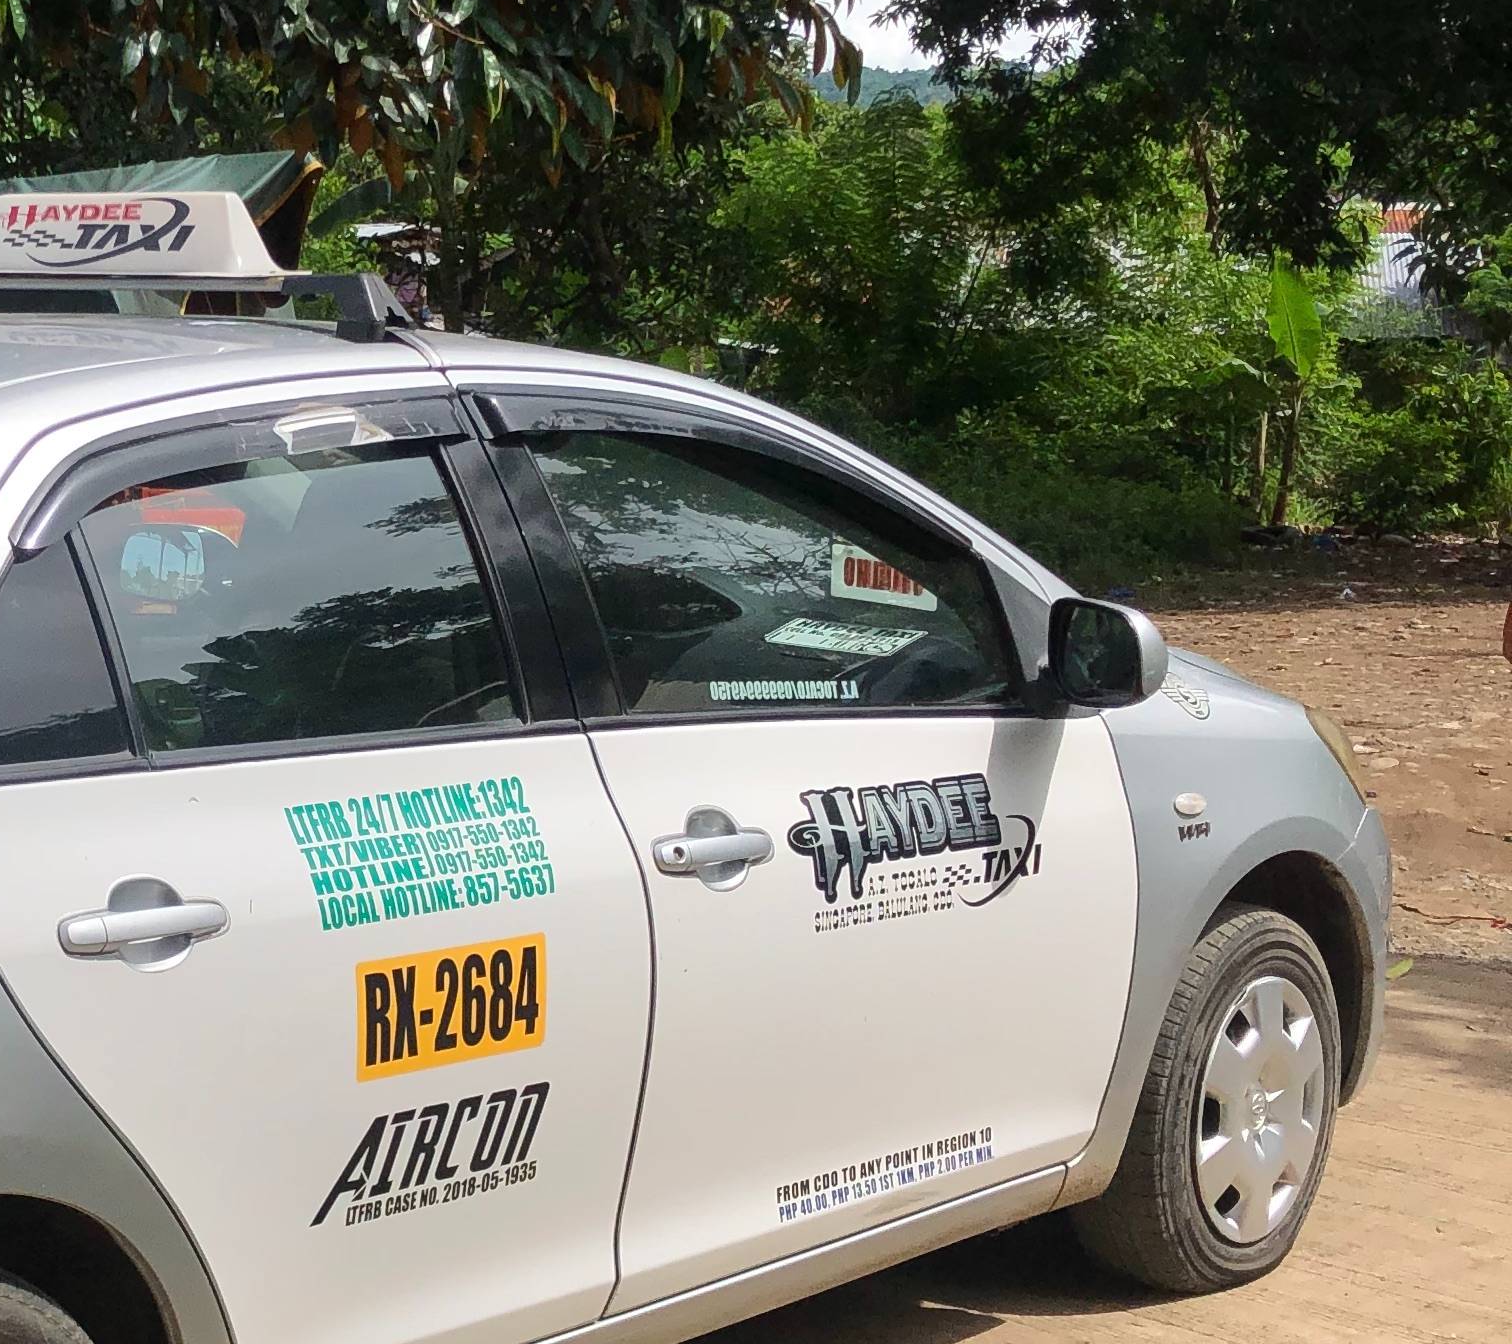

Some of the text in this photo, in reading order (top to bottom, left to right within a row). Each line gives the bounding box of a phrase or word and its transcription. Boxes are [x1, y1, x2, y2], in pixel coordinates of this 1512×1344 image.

[1, 203, 143, 231] HAYDEE
[74, 223, 195, 252] TAXI
[285, 801, 352, 846] LTFRB
[348, 793, 398, 836] 24/7
[426, 816, 541, 852] 0917-550-1342
[787, 773, 1002, 904] HAYDEE
[434, 840, 549, 875] 0917-550-1342
[892, 867, 938, 892] TOCALO
[318, 864, 556, 931] LOCAL HOTLINE: 857-5637
[364, 946, 539, 1067] RX-2684
[309, 1081, 551, 1228] AIRCON
[776, 1126, 992, 1204] FROM CDO TO ANY POINT IN REGION 10
[779, 1202, 798, 1223] PHP
[831, 1186, 850, 1206] PHP
[852, 1177, 878, 1200] 13.50
[879, 1172, 895, 1192] 1ST
[918, 1161, 936, 1180] PHP
[937, 1154, 957, 1175] 2.00
[958, 1150, 975, 1169] PER
[345, 1160, 537, 1226] LTFRB CASE NO. 2018-05-1935
